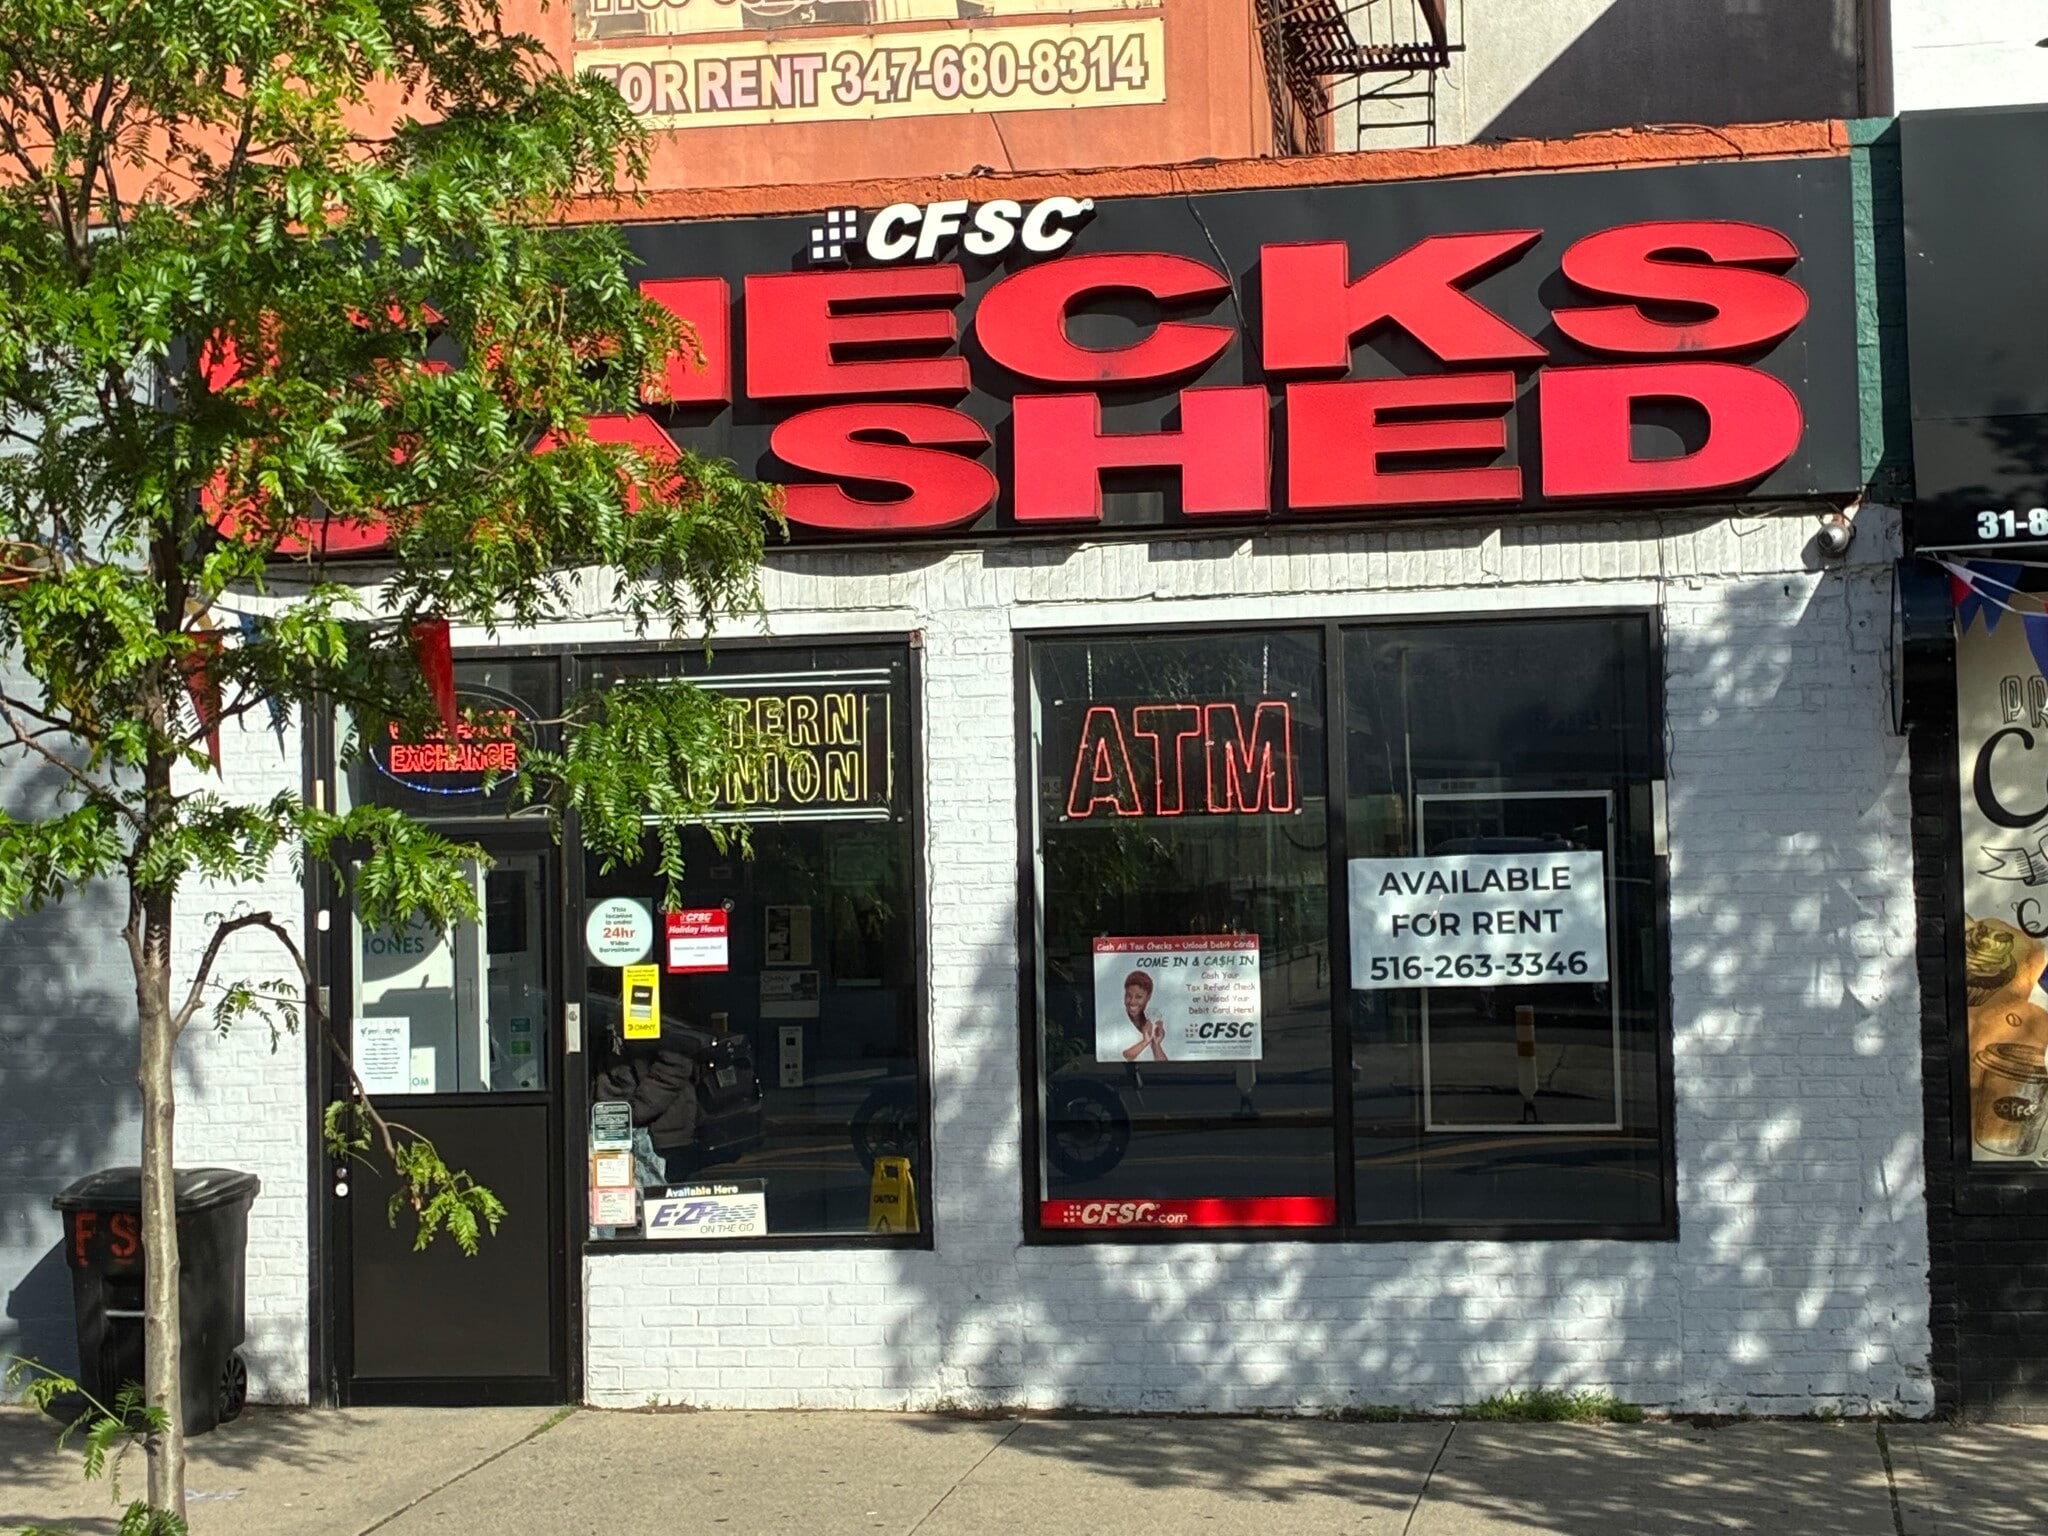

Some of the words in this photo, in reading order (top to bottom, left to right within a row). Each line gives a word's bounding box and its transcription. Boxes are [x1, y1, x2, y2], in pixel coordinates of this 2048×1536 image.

[694, 52, 826, 114] RENT
[832, 33, 1147, 104] 347-680-8314
[866, 196, 1084, 260] CFSC
[200, 220, 1809, 408] ECKS
[391, 743, 516, 773] EXCHANGE
[1067, 702, 1294, 817] ATM
[1379, 866, 1571, 896] AVAILABLE
[1392, 912, 1461, 938] FOR
[1473, 909, 1563, 936] RENT
[603, 927, 636, 939] 24hr
[1097, 943, 1115, 951] Cash
[1147, 942, 1173, 950] Checks
[1182, 941, 1208, 950] Unload
[1210, 941, 1231, 949] Debit
[1234, 940, 1256, 948] Cards
[1136, 957, 1169, 967] COME
[1173, 956, 1188, 967] IN
[1193, 957, 1200, 966] &
[1204, 955, 1235, 968] CA$H
[1239, 955, 1255, 966] IN
[1370, 950, 1588, 981] 516-263-3346
[1201, 971, 1219, 979] Cash
[1222, 971, 1240, 979] Your
[1203, 983, 1230, 992] Refund
[1233, 983, 1256, 991] Check
[1188, 1006, 1209, 1014] Debit
[1212, 1006, 1230, 1014] Card
[1199, 1022, 1255, 1039] CFSC
[665, 1186, 712, 1198] Available
[713, 1184, 739, 1194] Here
[700, 1225, 716, 1234] ON
[718, 1224, 737, 1233] THE
